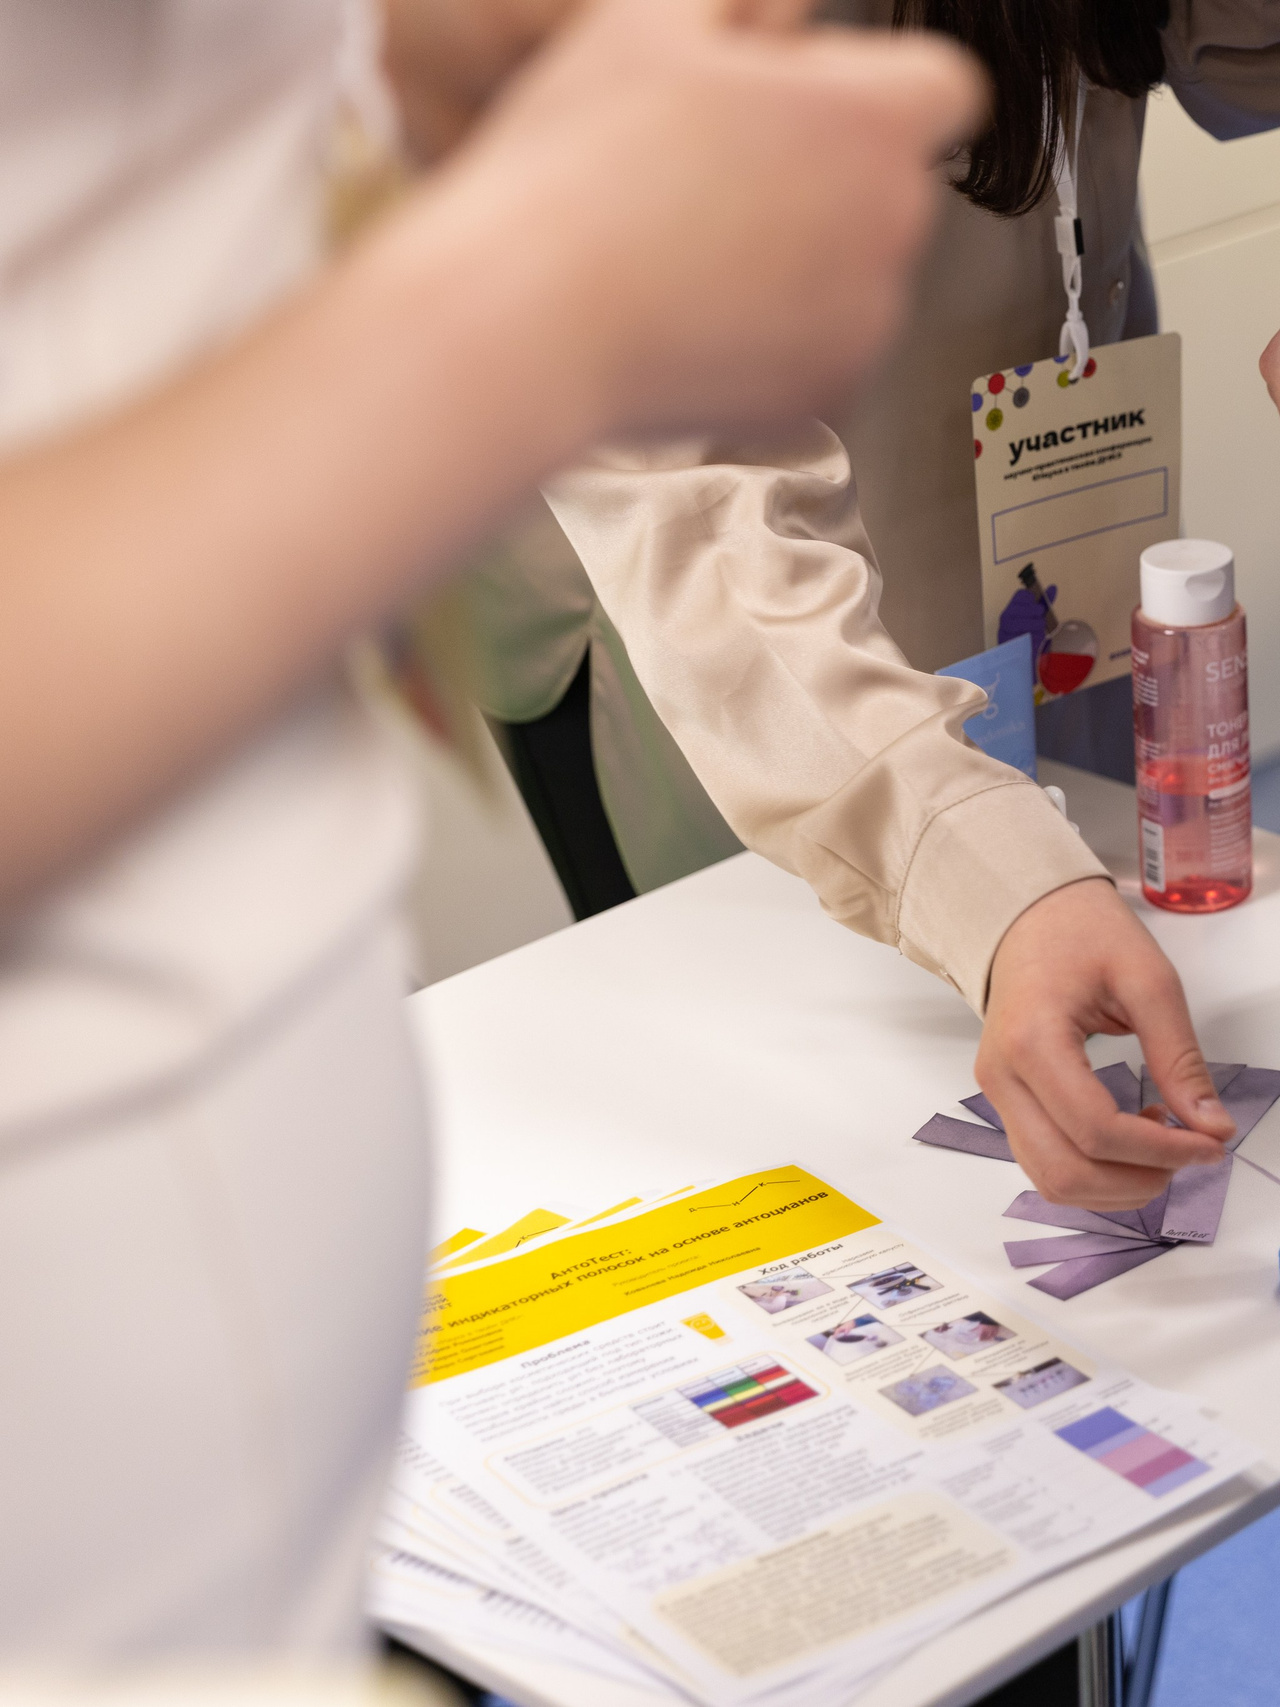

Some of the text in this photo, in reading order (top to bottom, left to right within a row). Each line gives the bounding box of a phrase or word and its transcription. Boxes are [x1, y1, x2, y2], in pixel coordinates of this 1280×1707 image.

[1009, 408, 1145, 466] участник
[448, 1280, 572, 1328] индикаторных
[576, 1255, 647, 1283] полосок
[648, 1246, 670, 1258] на
[672, 1224, 731, 1250] основе
[733, 1191, 829, 1229] антоцианов
[549, 1249, 632, 1280] АнтоТест:
[758, 1244, 844, 1276] Ход работы
[519, 1338, 591, 1369] Проблема
